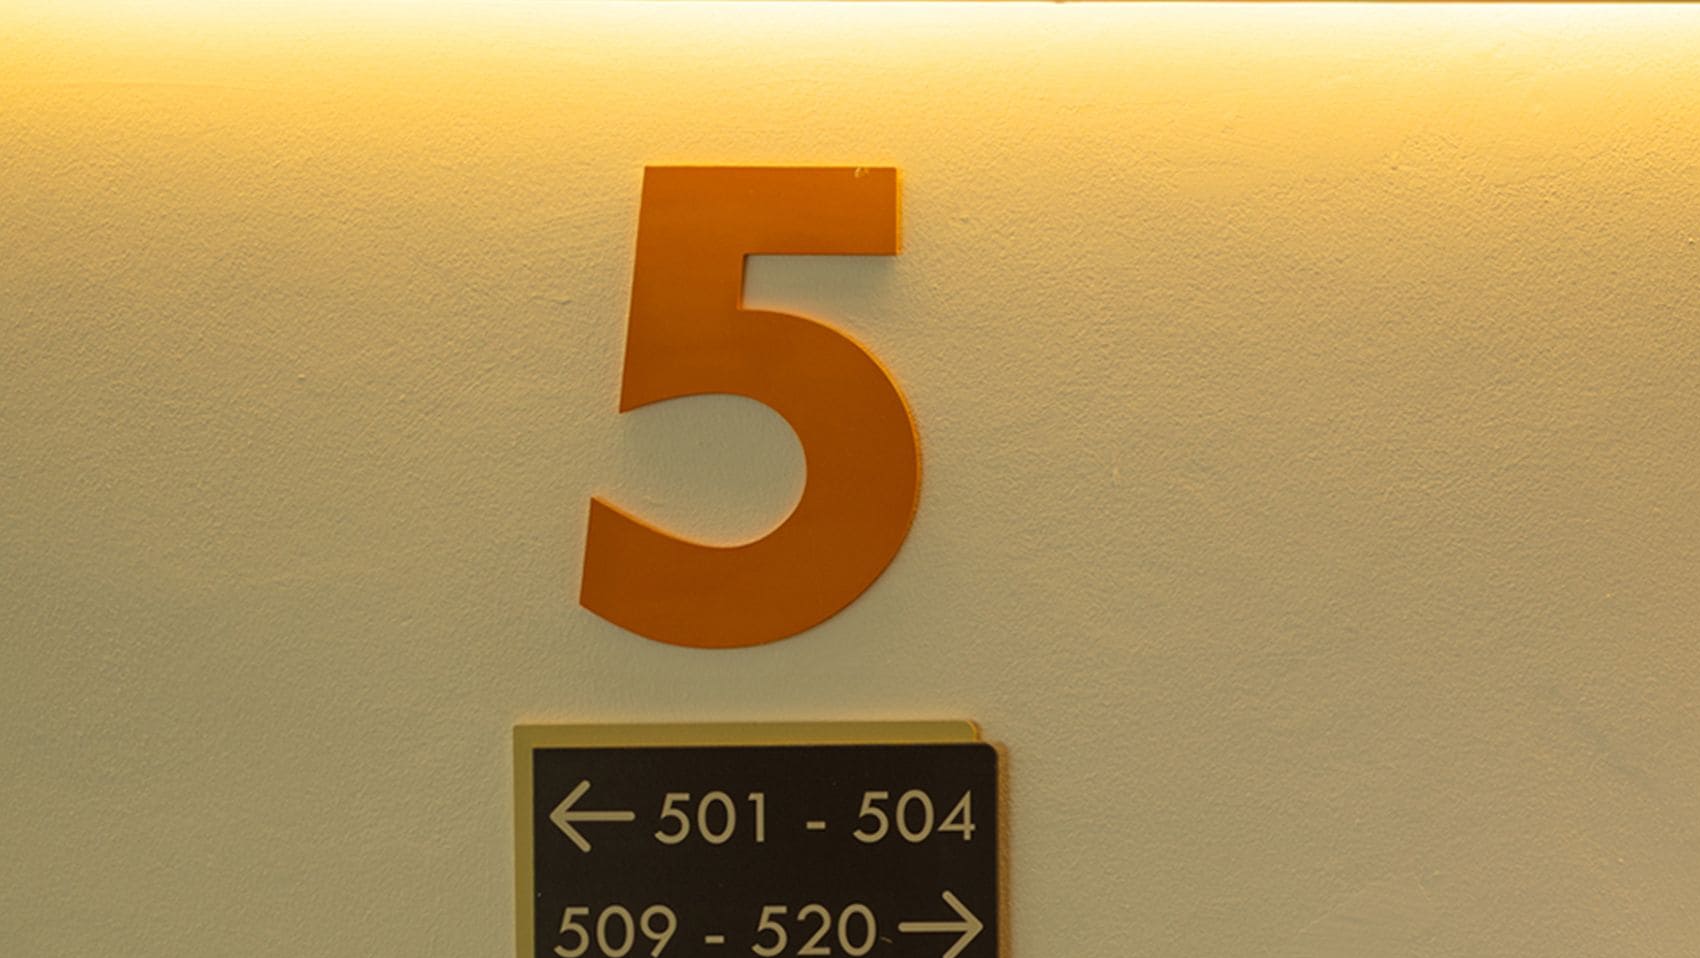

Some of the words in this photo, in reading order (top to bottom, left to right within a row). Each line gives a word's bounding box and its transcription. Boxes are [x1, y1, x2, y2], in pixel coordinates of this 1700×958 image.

[578, 165, 922, 649] 5
[654, 790, 765, 845] 501
[852, 789, 976, 843] 504
[553, 904, 678, 958] 509
[751, 903, 877, 958] 520
